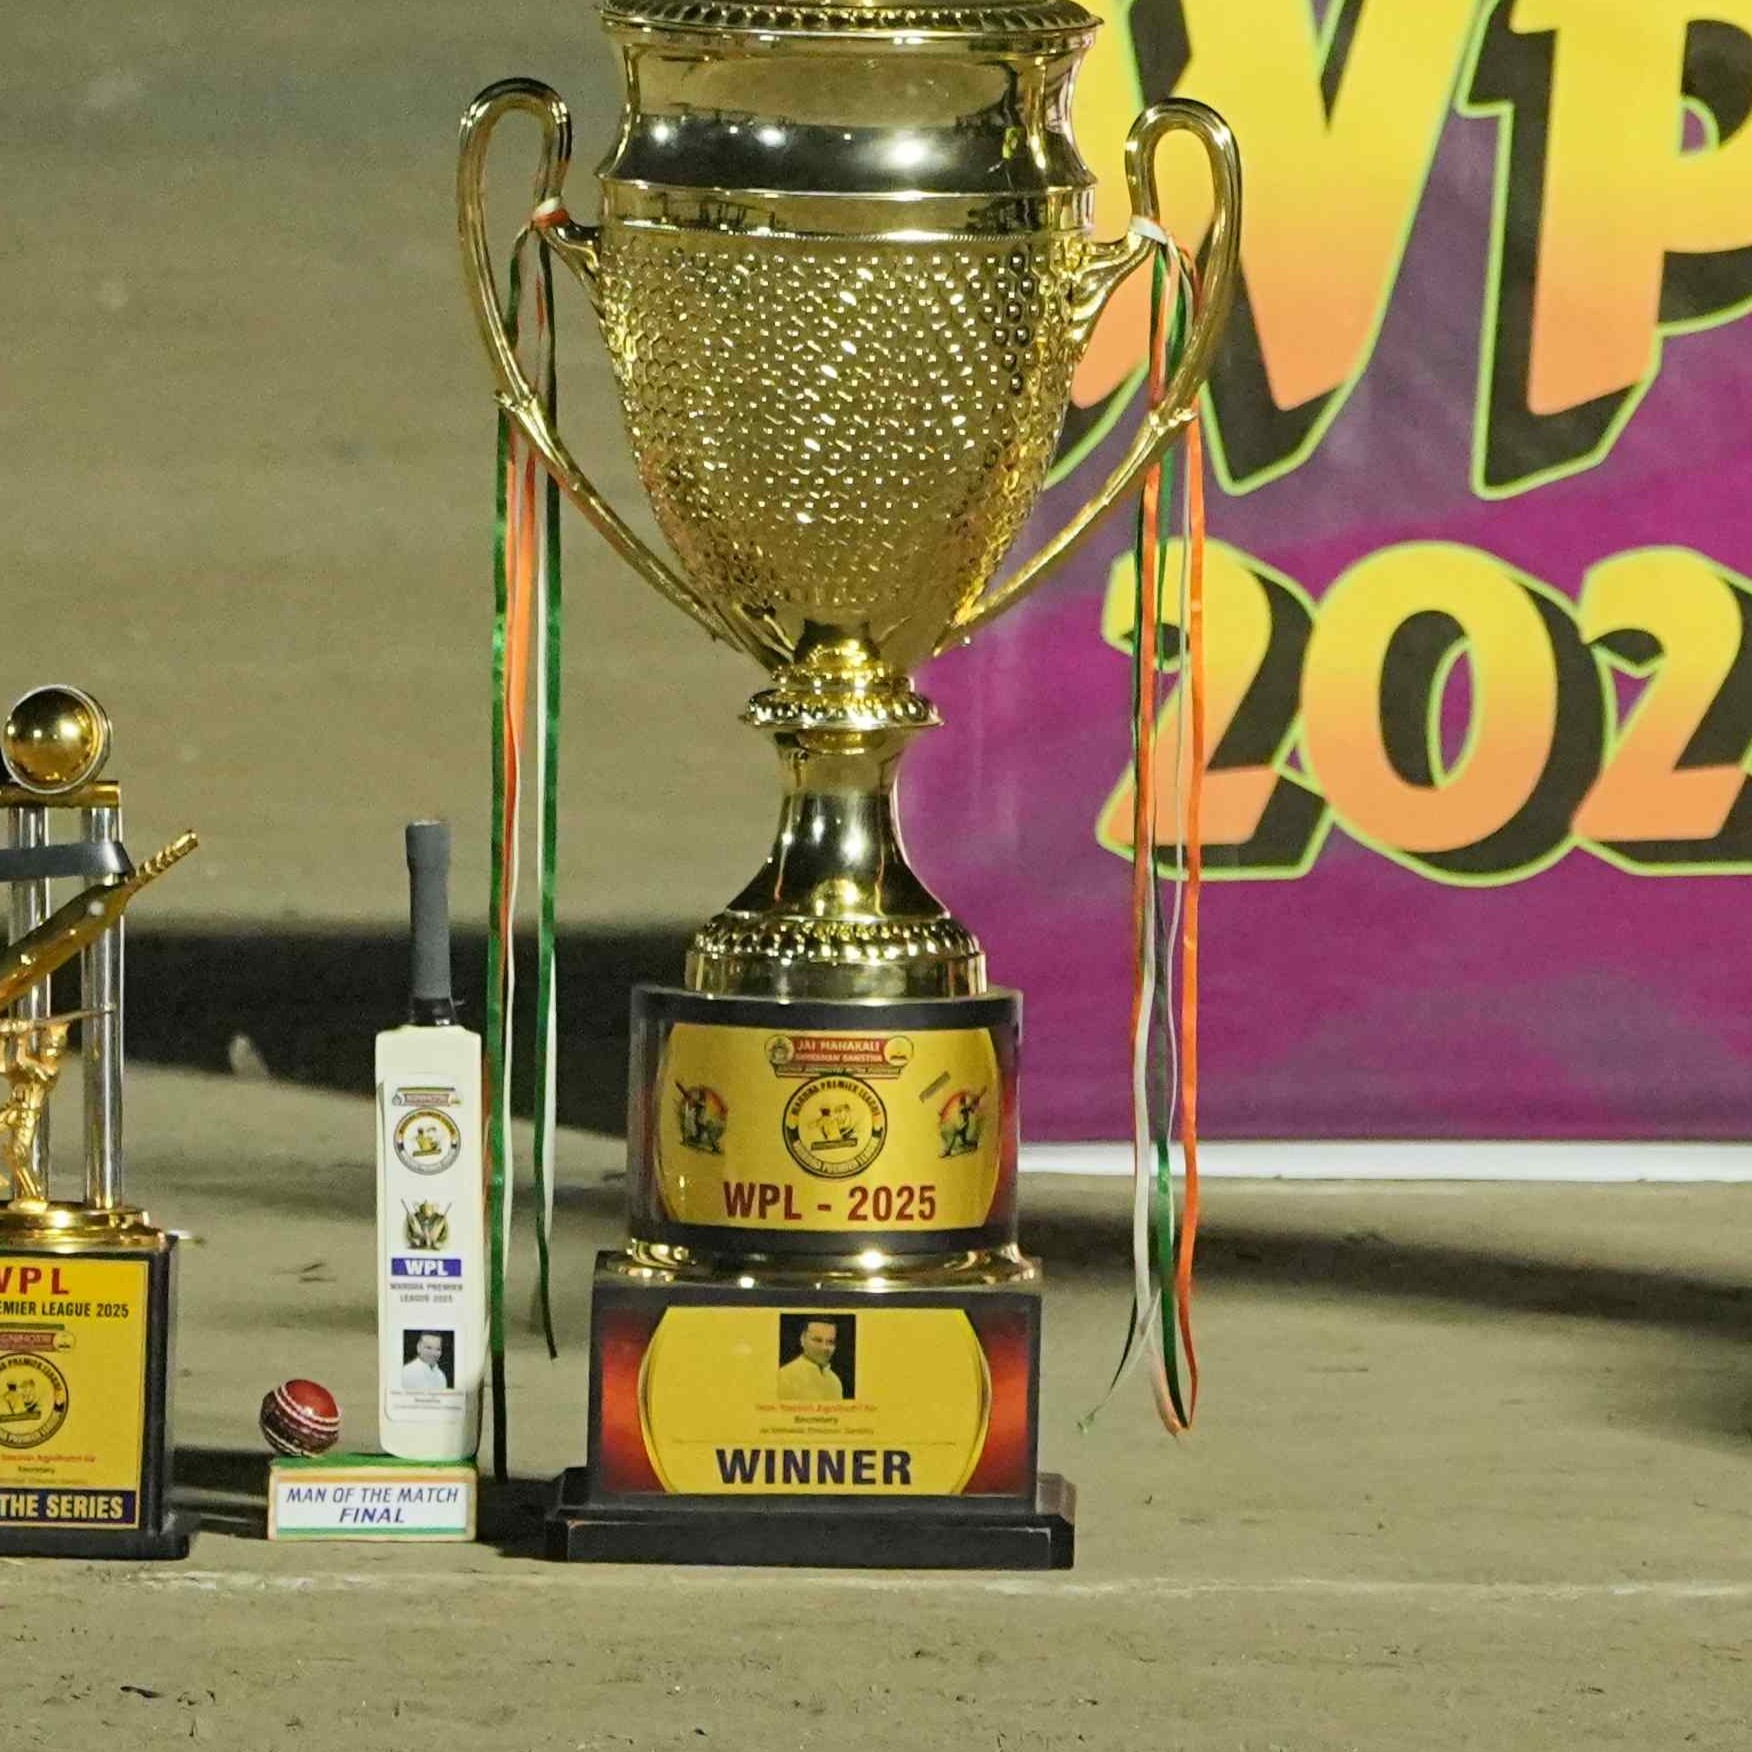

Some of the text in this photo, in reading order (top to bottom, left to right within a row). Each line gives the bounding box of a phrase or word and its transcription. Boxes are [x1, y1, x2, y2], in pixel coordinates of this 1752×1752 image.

[723, 1180, 936, 1222] WPL - 2025
[404, 1258, 449, 1277] WPL
[41, 1302, 92, 1318] LEAGUE
[96, 1303, 130, 1319] 2025
[715, 1448, 912, 1486] WINNER
[286, 1487, 460, 1504] MAN OF THE MATCH
[45, 1494, 124, 1520] SERIES
[338, 1507, 406, 1524] FINAL
